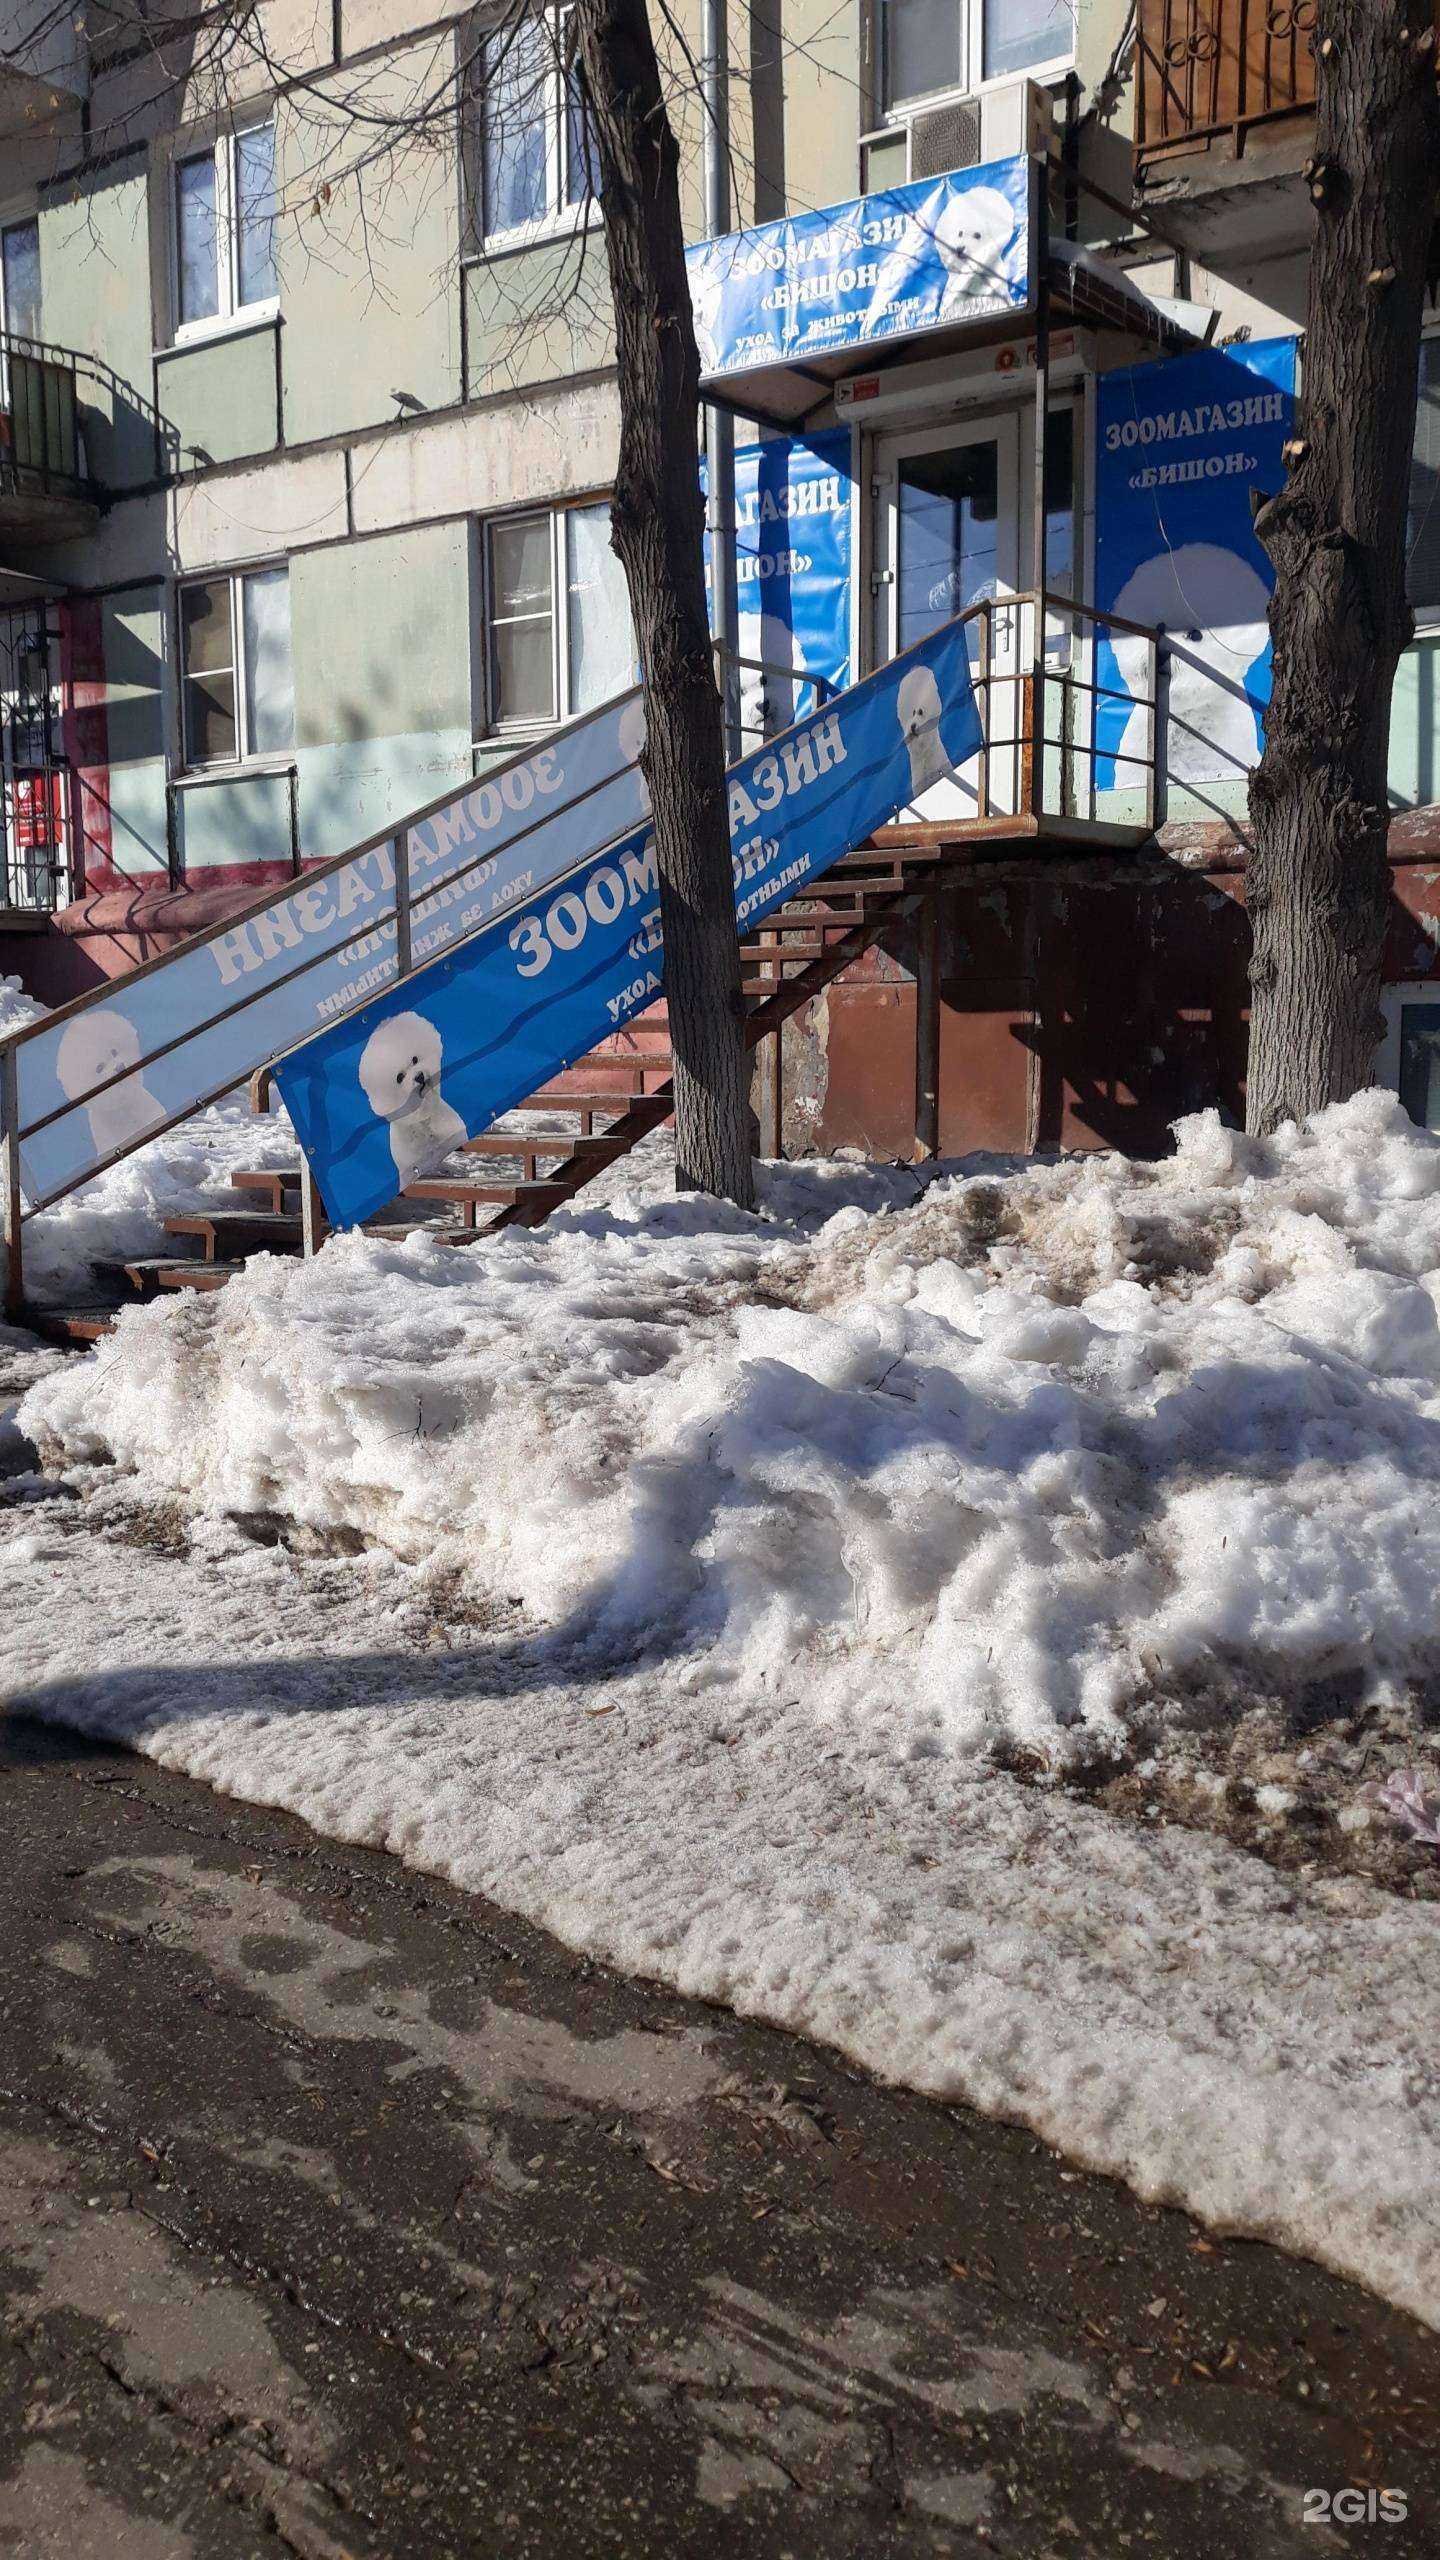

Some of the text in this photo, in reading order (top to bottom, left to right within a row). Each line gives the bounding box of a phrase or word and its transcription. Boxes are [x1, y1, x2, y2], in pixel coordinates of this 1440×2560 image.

[761, 262, 890, 310] «БИШОН
[808, 296, 920, 336] ЖИВОТЫМИ
[1105, 392, 1284, 450] ЗООМАГАЗИН
[1128, 452, 1258, 489] «БИШОН»
[508, 712, 848, 978] ЗООМАЗИН
[606, 852, 812, 1022] УХОД ОТНЫМИ
